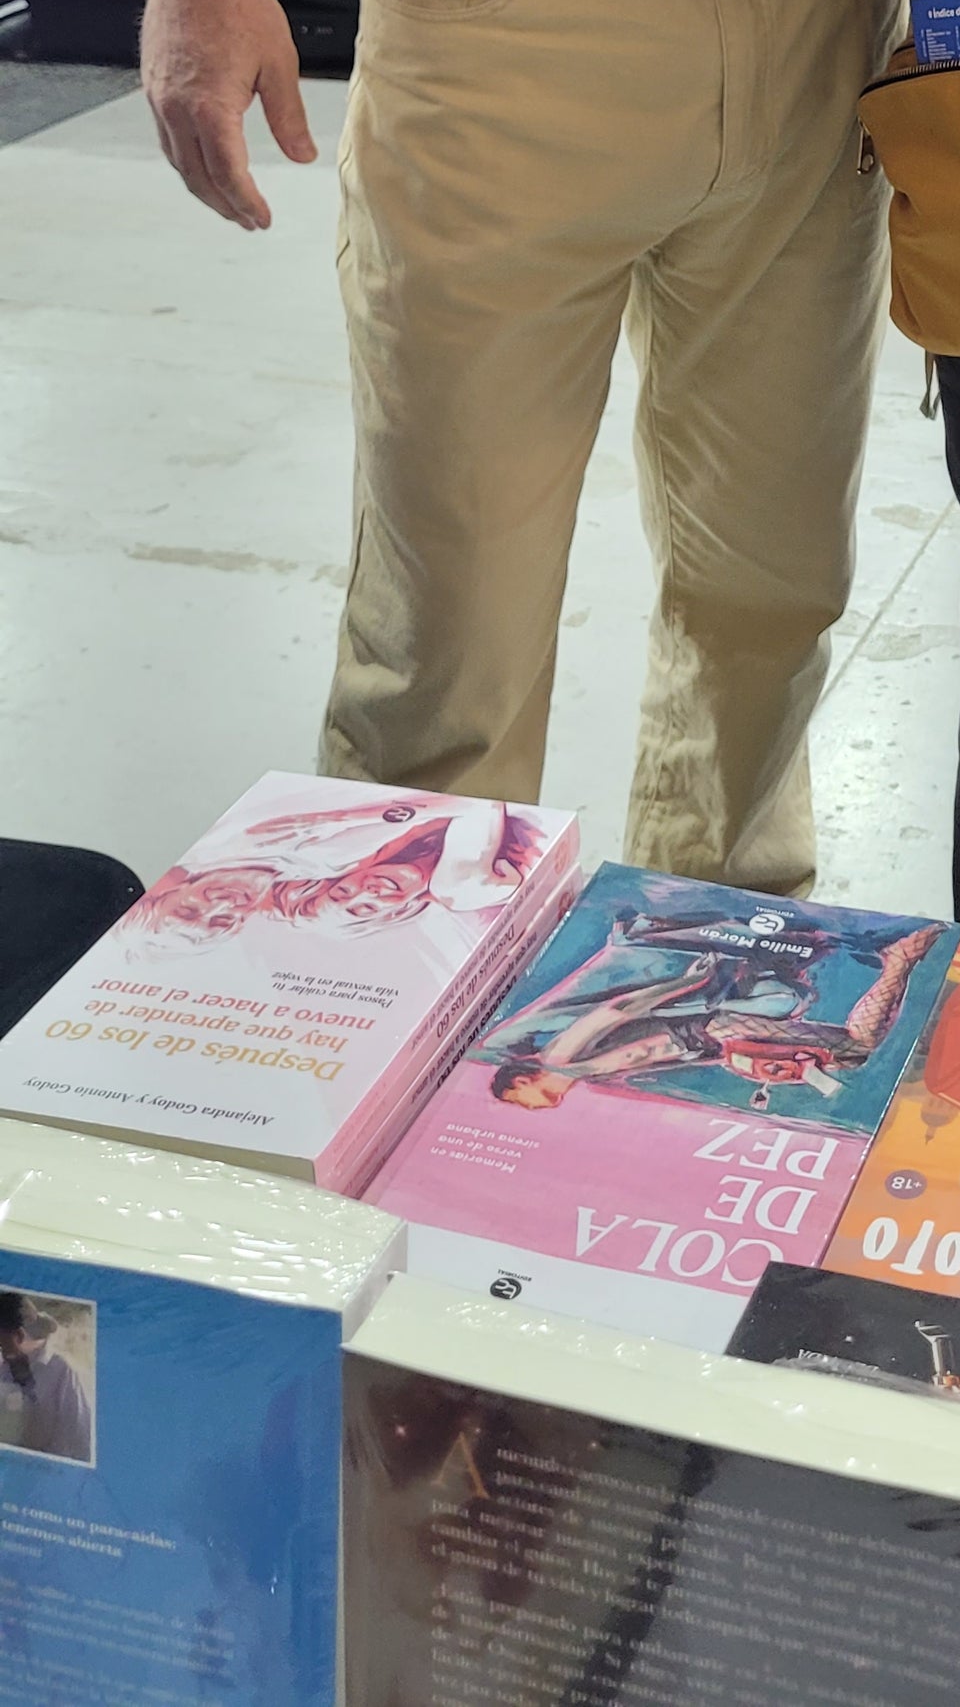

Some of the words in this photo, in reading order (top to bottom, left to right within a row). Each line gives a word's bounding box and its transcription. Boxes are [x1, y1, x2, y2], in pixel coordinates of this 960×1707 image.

[699, 929, 757, 948] Morán
[478, 923, 520, 978] Después
[760, 940, 813, 958] Emilio
[272, 972, 300, 981] vejez
[305, 976, 315, 985] la
[317, 977, 333, 985] en
[91, 979, 162, 996] amor
[272, 982, 286, 991] tu
[289, 984, 326, 996] cuidar
[332, 981, 373, 992] sexual
[375, 985, 399, 996] vida
[465, 974, 481, 997] de
[161, 988, 189, 1002] el
[329, 991, 358, 1001] para
[358, 996, 393, 1009] Pasos
[84, 1000, 117, 1015] de
[192, 993, 268, 1017] hacer
[274, 1005, 290, 1017] a
[450, 991, 469, 1018] los
[119, 1005, 239, 1032] aprender
[294, 1009, 375, 1030] nuevo
[434, 1012, 453, 1039] 60
[45, 1019, 92, 1041] 60
[98, 1026, 150, 1050] los
[244, 1021, 293, 1041] que
[153, 1035, 196, 1056] de
[296, 1029, 349, 1053] hay
[200, 1042, 346, 1081] Después
[23, 1076, 71, 1094] Godoy
[75, 1086, 134, 1103] Antonio
[135, 1094, 150, 1104] y
[149, 1100, 197, 1115] Godoy
[201, 1106, 275, 1127] Alejandra
[446, 1123, 495, 1139] urbana
[438, 1135, 463, 1146] una
[466, 1142, 482, 1152] de
[499, 1134, 540, 1148] sirena
[430, 1146, 446, 1156] en
[487, 1145, 522, 1158] verso
[693, 1118, 840, 1181] PEZ
[449, 1151, 516, 1174] Memorias
[891, 1175, 923, 1190] +18
[704, 1175, 817, 1235] DE
[576, 1206, 783, 1287] COLA
[22, 1507, 63, 1524] como
[67, 1516, 85, 1529] un
